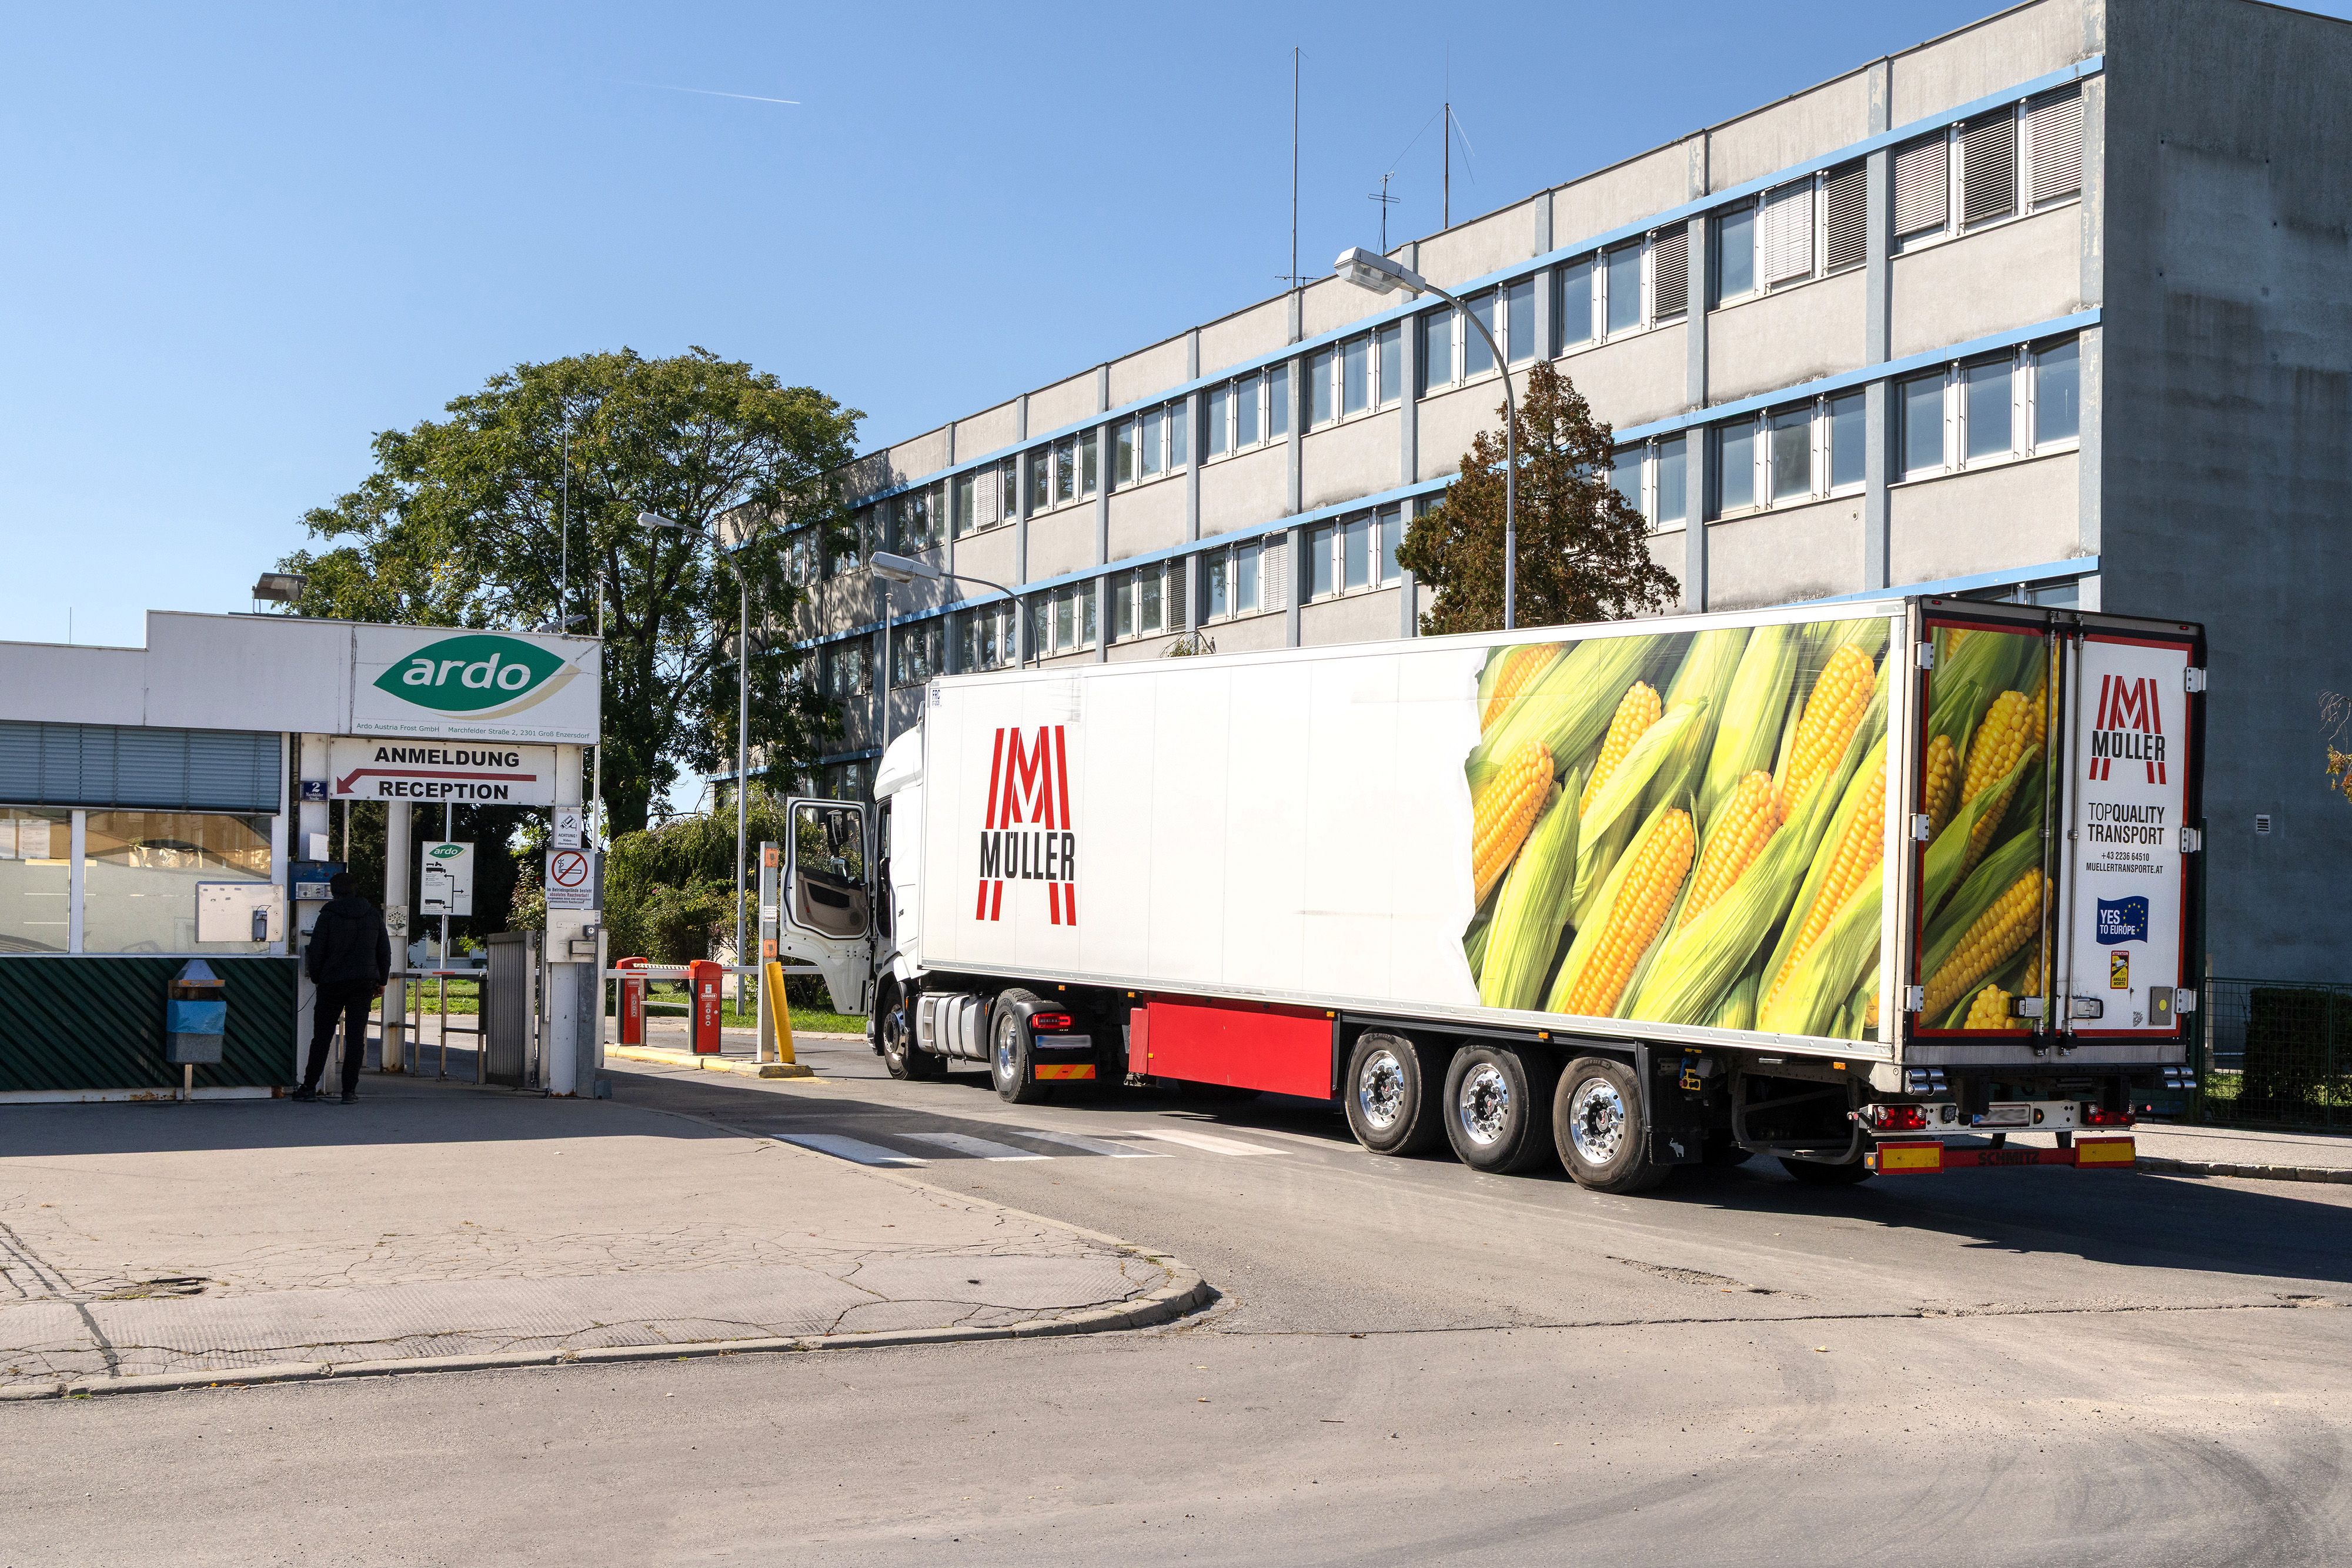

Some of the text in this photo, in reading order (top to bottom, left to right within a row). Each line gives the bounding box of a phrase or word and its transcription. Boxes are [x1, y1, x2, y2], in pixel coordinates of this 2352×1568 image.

[403, 653, 531, 690] ardo
[932, 689, 941, 700] FRC
[2092, 731, 2165, 761] MÜLLER
[374, 747, 519, 767] ANMELDUNG
[312, 782, 320, 793] 2
[379, 781, 509, 800] RECEPTION
[2087, 824, 2164, 845] TRANSPORT
[980, 831, 1075, 881] MÜLLER
[2102, 851, 2150, 861] +43 2236 64510
[2086, 862, 2163, 874] MUELLERTRANSPORTE.AT
[2100, 910, 2120, 924] YES
[2100, 925, 2136, 935] TO EUROPE
[1978, 1151, 2039, 1165] SCHMITZ
